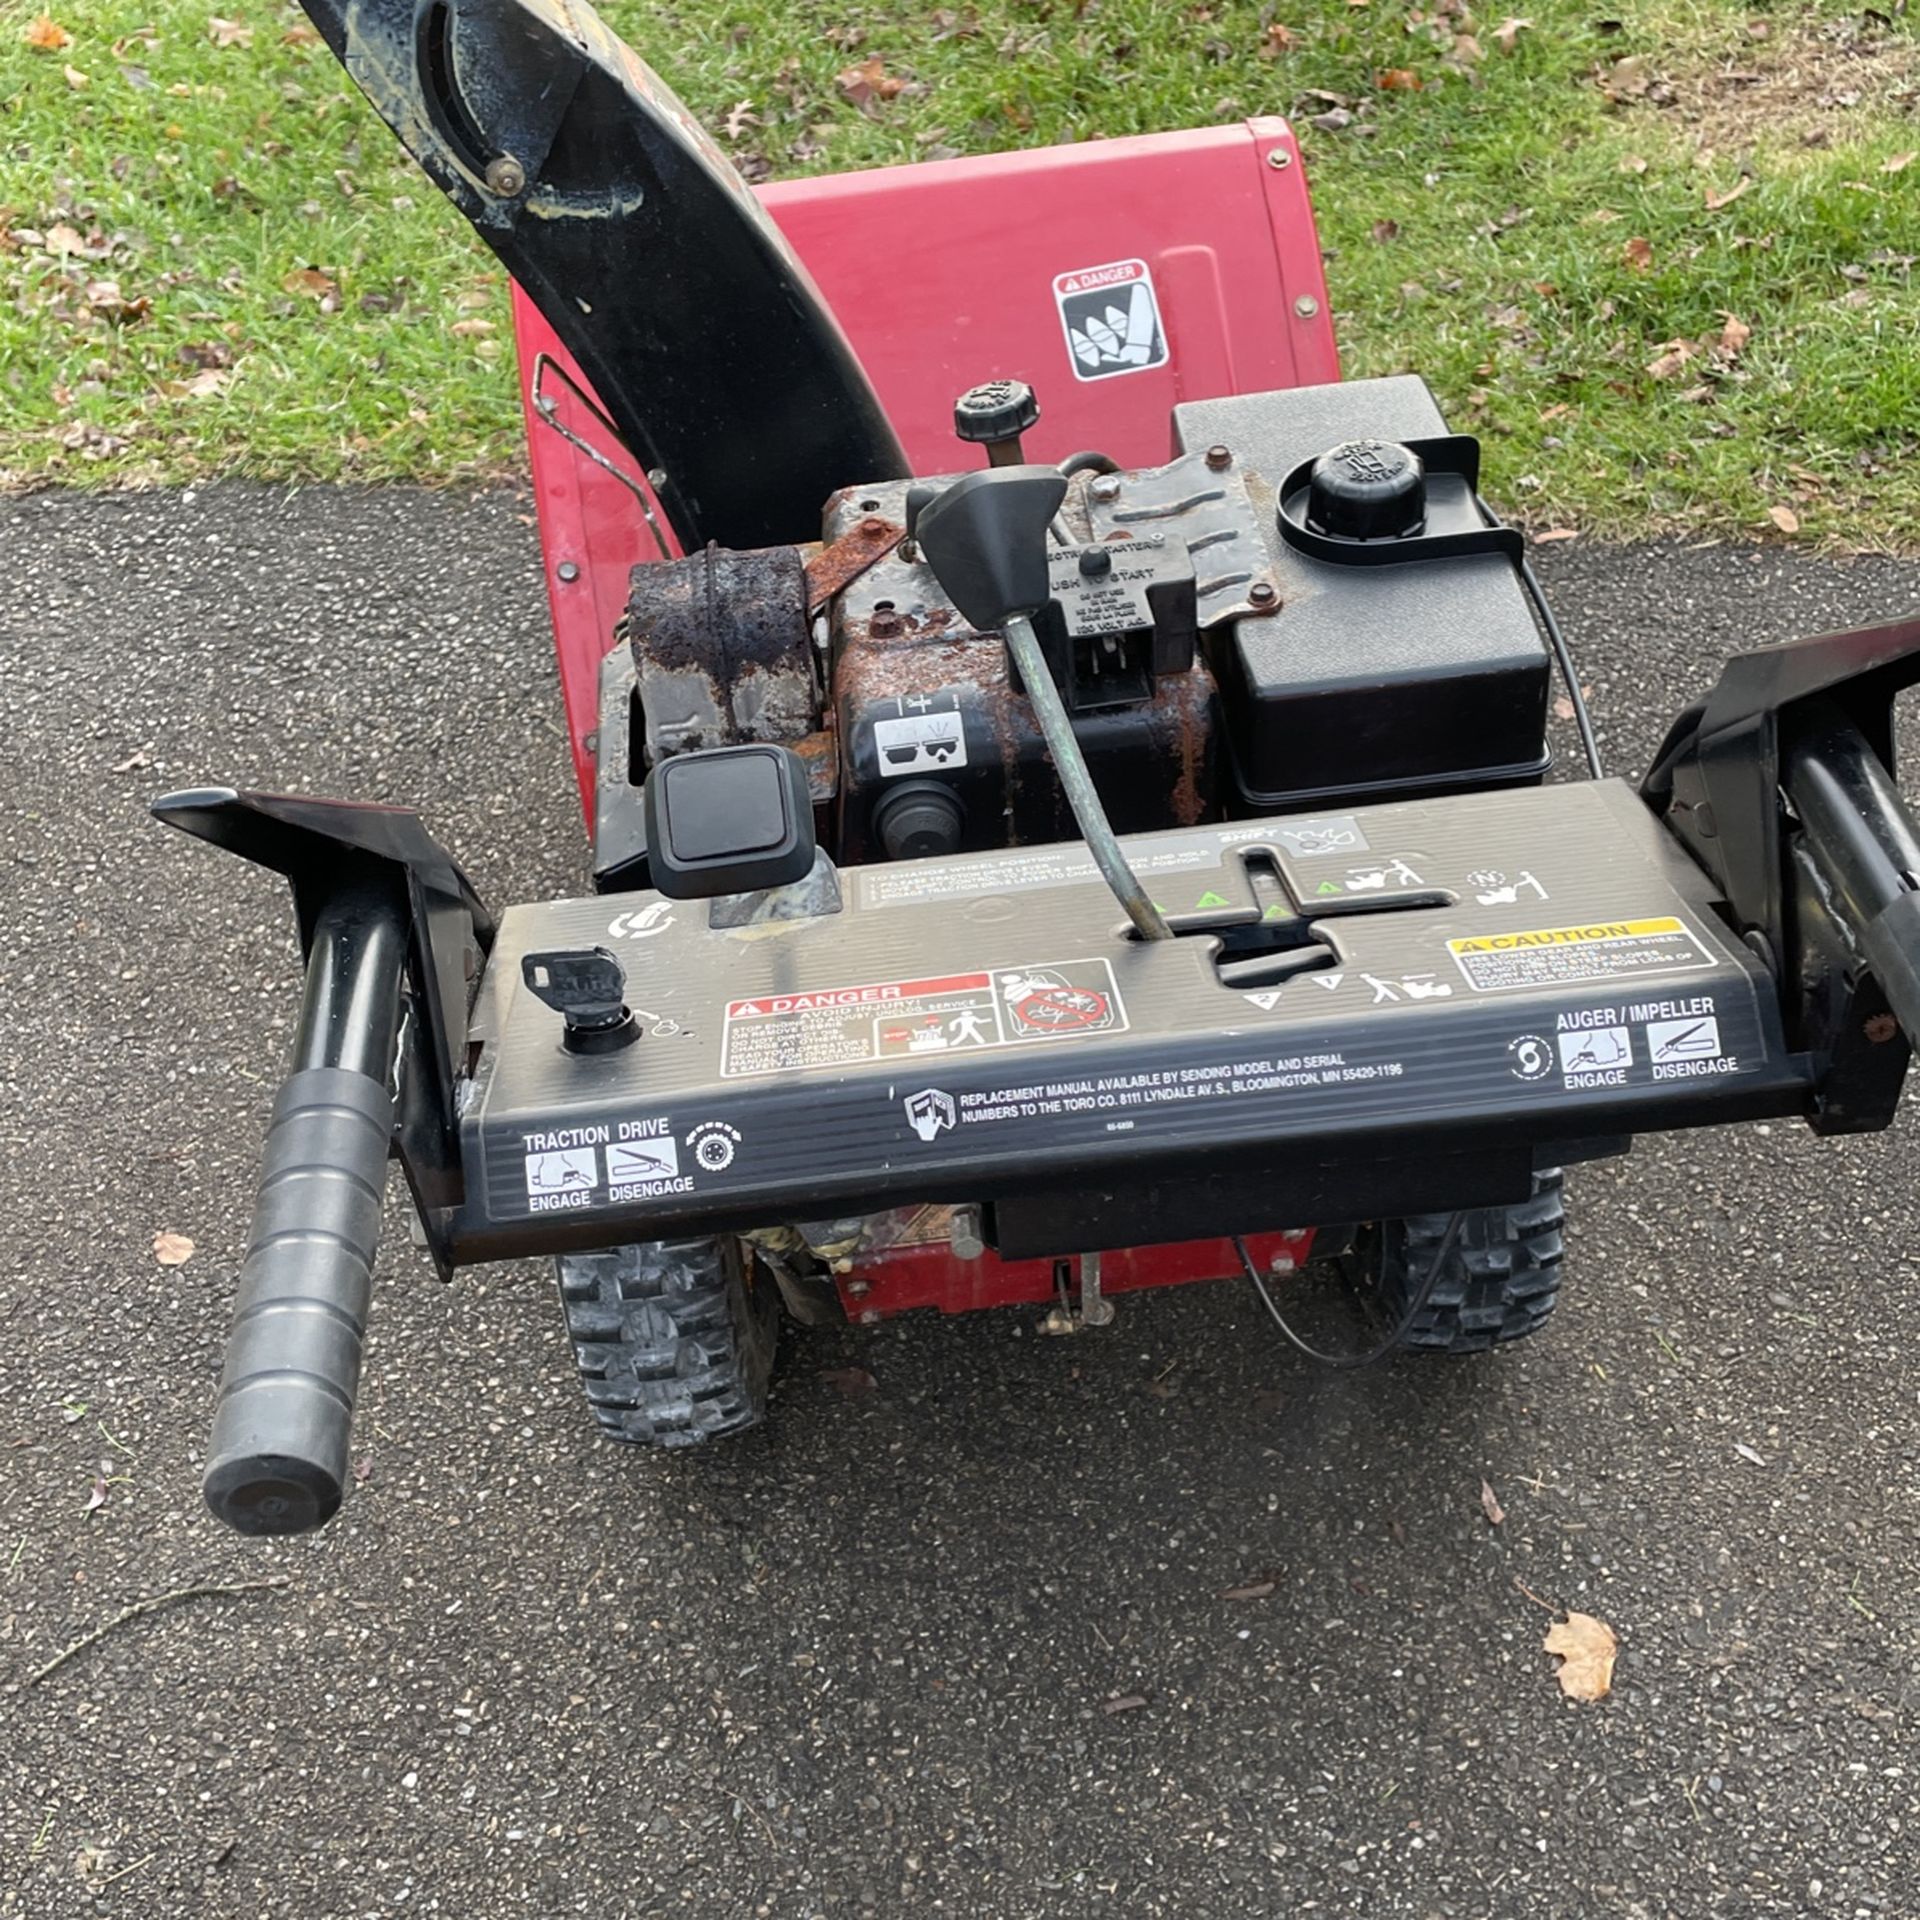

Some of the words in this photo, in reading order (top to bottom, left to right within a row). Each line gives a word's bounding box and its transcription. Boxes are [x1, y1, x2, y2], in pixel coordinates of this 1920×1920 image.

[1080, 264, 1136, 289] DANGER
[1103, 541, 1153, 554] TARTER
[1051, 579, 1080, 591] USH
[1110, 568, 1154, 583] START
[1490, 925, 1631, 949] CAUTION
[772, 986, 901, 1012] DANGER
[800, 1007, 851, 1019] AVOID
[1557, 1006, 1617, 1030] AUGER
[1629, 997, 1715, 1022] IMPELLER
[960, 1086, 1045, 1107] REPLACEMENT
[1046, 1080, 1095, 1098] MANUAL
[1097, 1073, 1160, 1091] AVAILABLE
[1162, 1071, 1179, 1084] BY
[1180, 1065, 1232, 1082] SENDING
[1234, 1060, 1275, 1077] MODEL
[1277, 1057, 1302, 1071] AND
[1304, 1053, 1346, 1068] SERIAL
[1564, 1069, 1628, 1090] ENGAGE
[1652, 1057, 1739, 1081] DISENGAGE
[961, 1105, 1019, 1123] NUMBERS
[1020, 1102, 1038, 1117] TO
[1038, 1100, 1063, 1114] THE
[1063, 1096, 1096, 1112] TORO
[1097, 1094, 1118, 1108] CO.
[1120, 1090, 1142, 1106] 8111
[1144, 1085, 1196, 1103] LYNDALE
[1231, 1072, 1321, 1093] BLOOMINGTON,
[1322, 1068, 1341, 1083] MN
[1342, 1063, 1403, 1082] 55420-1196
[523, 1125, 609, 1151] TRACTION
[618, 1117, 670, 1141] DRIVE
[529, 1190, 591, 1212] ENGAGE
[609, 1176, 695, 1202] DISENGAGE
